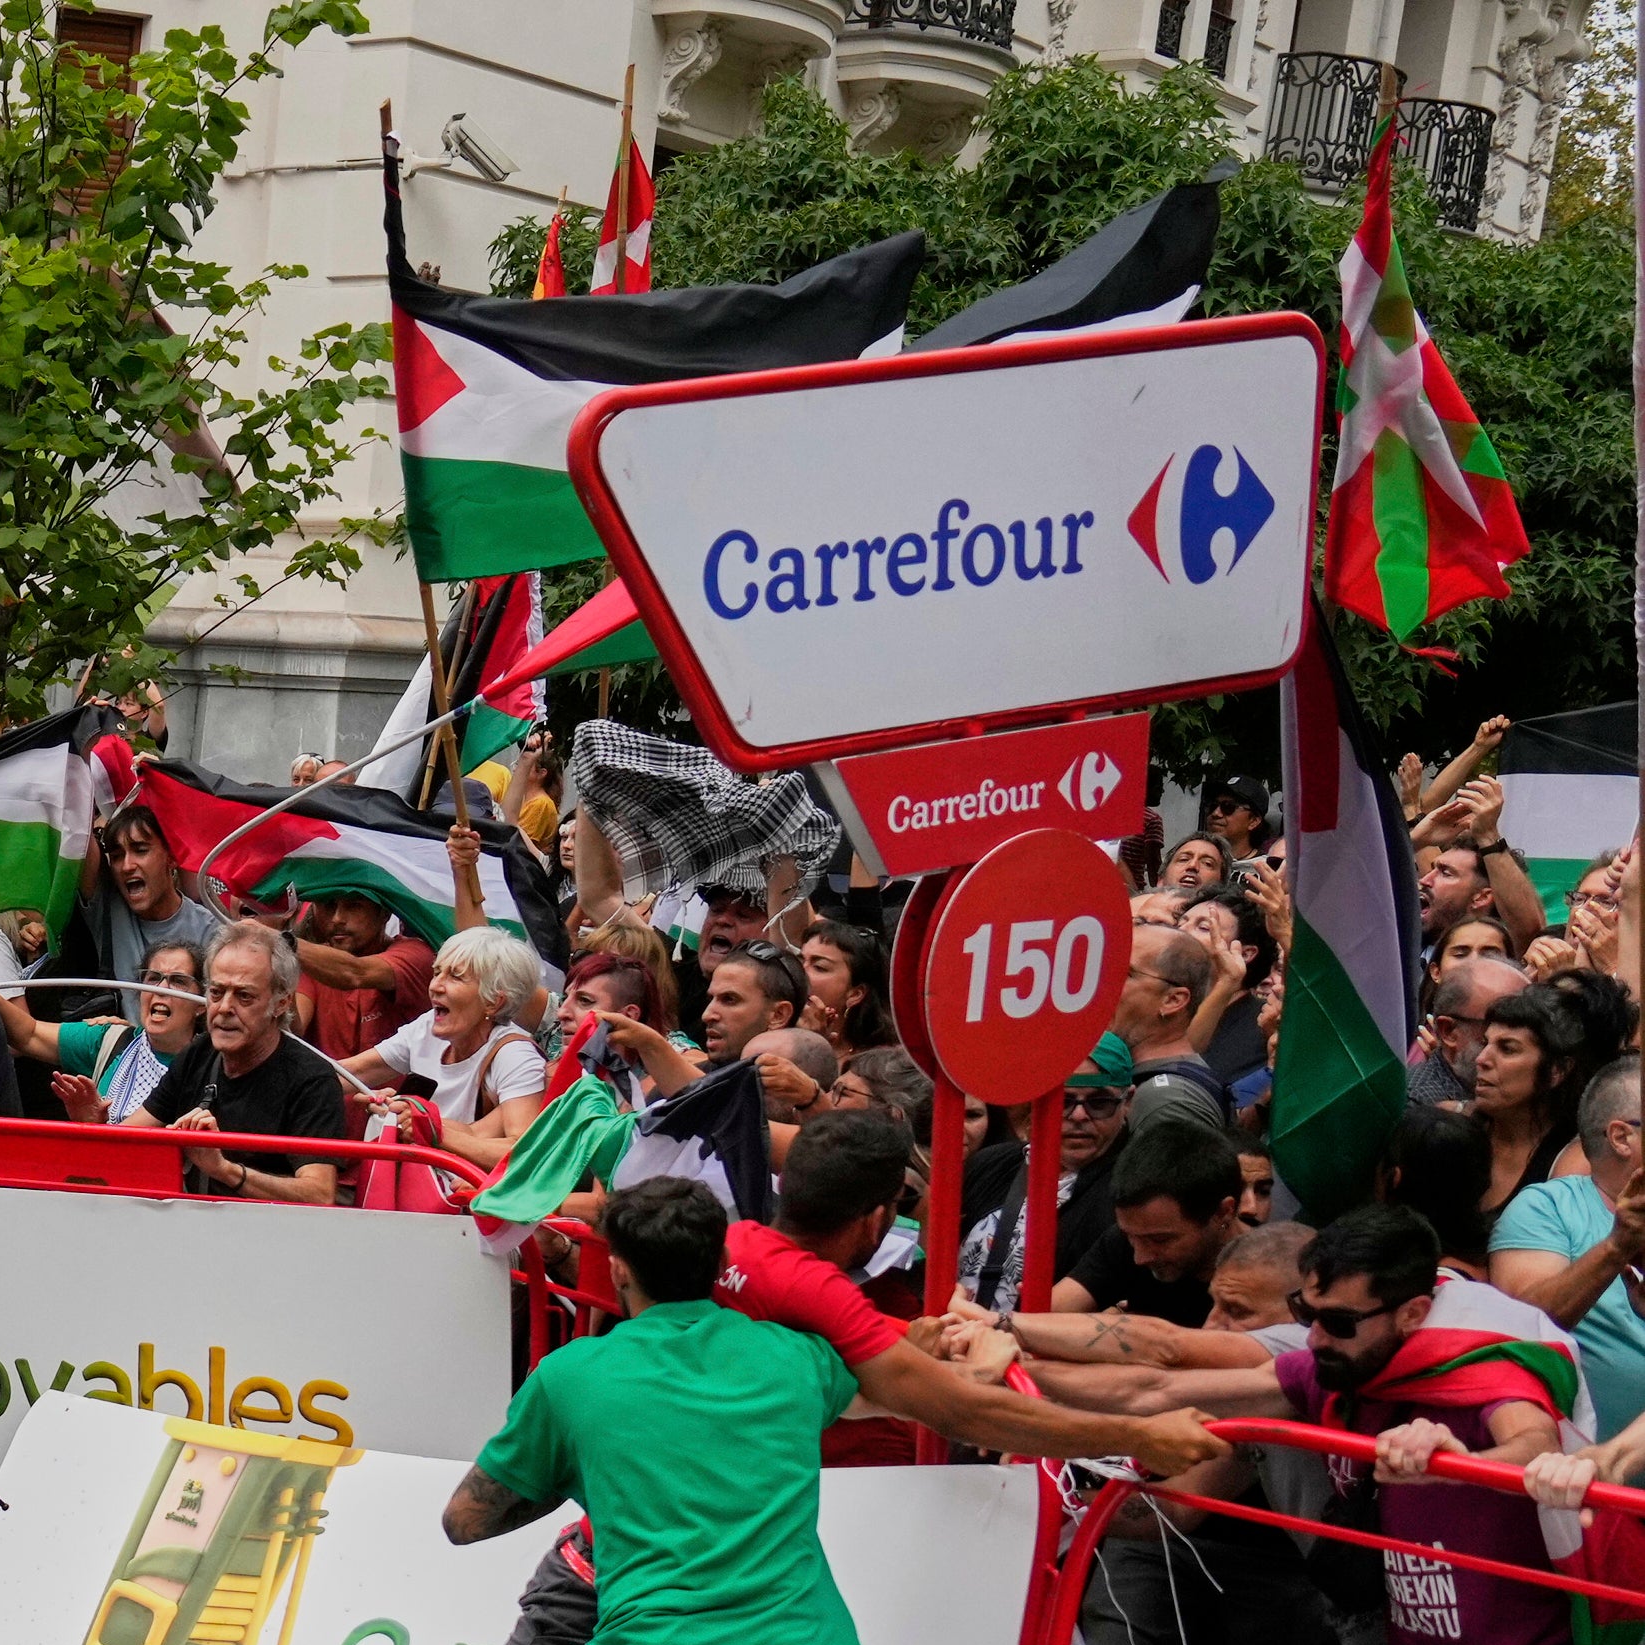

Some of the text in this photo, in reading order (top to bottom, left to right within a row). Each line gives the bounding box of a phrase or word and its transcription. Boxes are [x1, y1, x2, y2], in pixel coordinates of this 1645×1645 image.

[704, 499, 1094, 620] Carrefour
[888, 776, 1044, 835] Carrefour
[963, 914, 1106, 1023] 150
